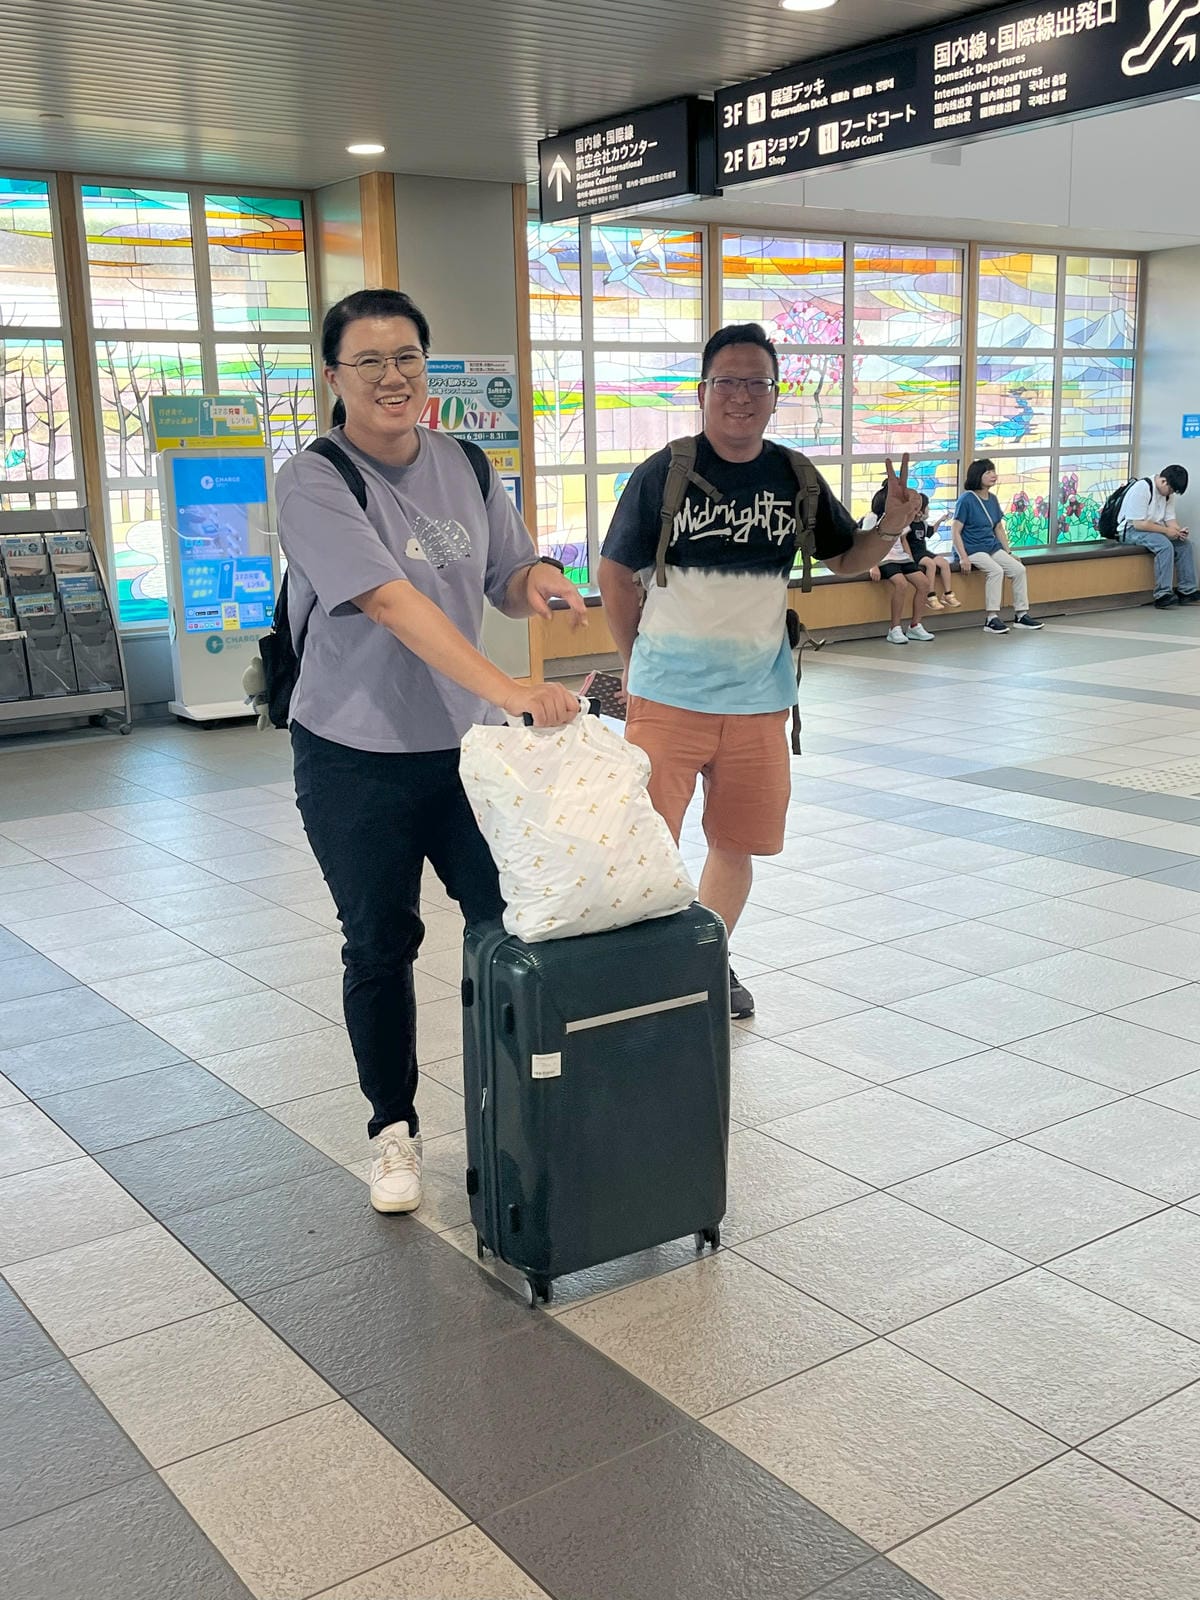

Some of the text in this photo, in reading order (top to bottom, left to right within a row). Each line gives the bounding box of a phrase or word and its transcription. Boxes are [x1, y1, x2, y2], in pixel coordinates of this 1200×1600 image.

[934, 53, 1026, 85] Domestic Departures
[771, 77, 826, 107] 展望デッキ
[934, 66, 1043, 100] International Departures
[723, 102, 743, 129] 3F
[771, 96, 829, 119] Observation Deck
[840, 103, 917, 137] フードコート
[767, 127, 811, 154] ショップ
[840, 132, 884, 151] Food Court
[576, 139, 658, 171] 航空会社カウンター
[723, 148, 744, 174] 2F
[768, 154, 787, 167] Shop
[576, 168, 601, 182] Domestic
[605, 157, 643, 174] International
[576, 179, 595, 191] Airline
[595, 174, 618, 186] Counter
[463, 411, 502, 430] OFF
[669, 490, 791, 548] Midnight
